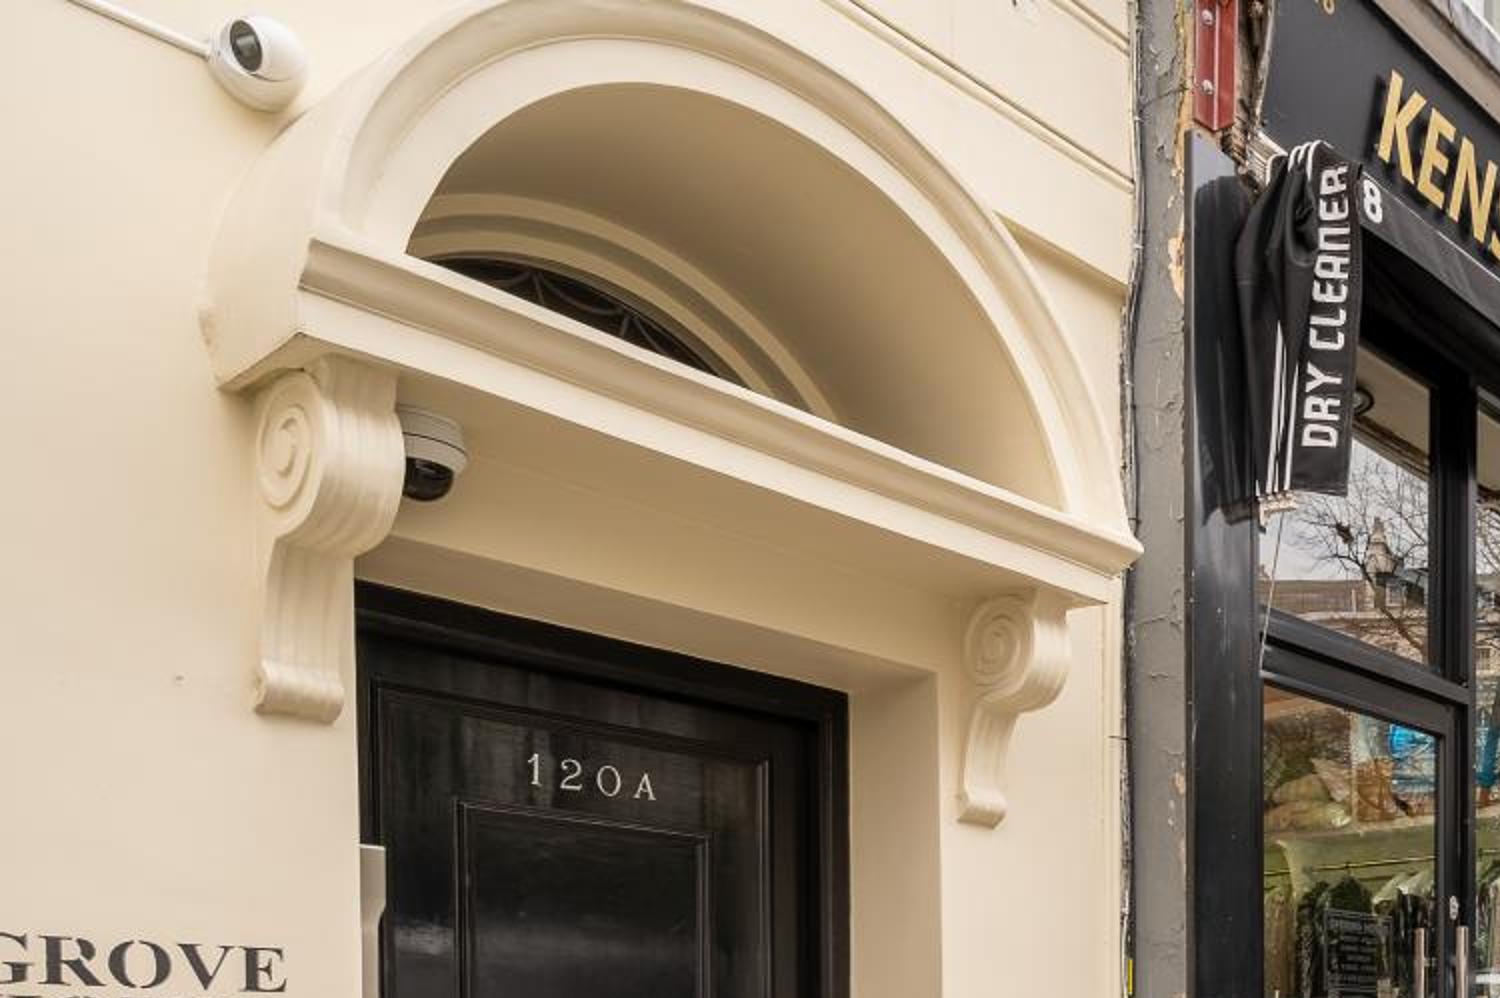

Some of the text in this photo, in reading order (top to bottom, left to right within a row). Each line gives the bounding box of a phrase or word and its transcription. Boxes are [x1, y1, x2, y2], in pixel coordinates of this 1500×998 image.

[1363, 178, 1383, 225] 8
[1302, 165, 1351, 448] DRY CLEANER
[527, 752, 657, 801] 120A
[0, 931, 287, 993] GROVE
